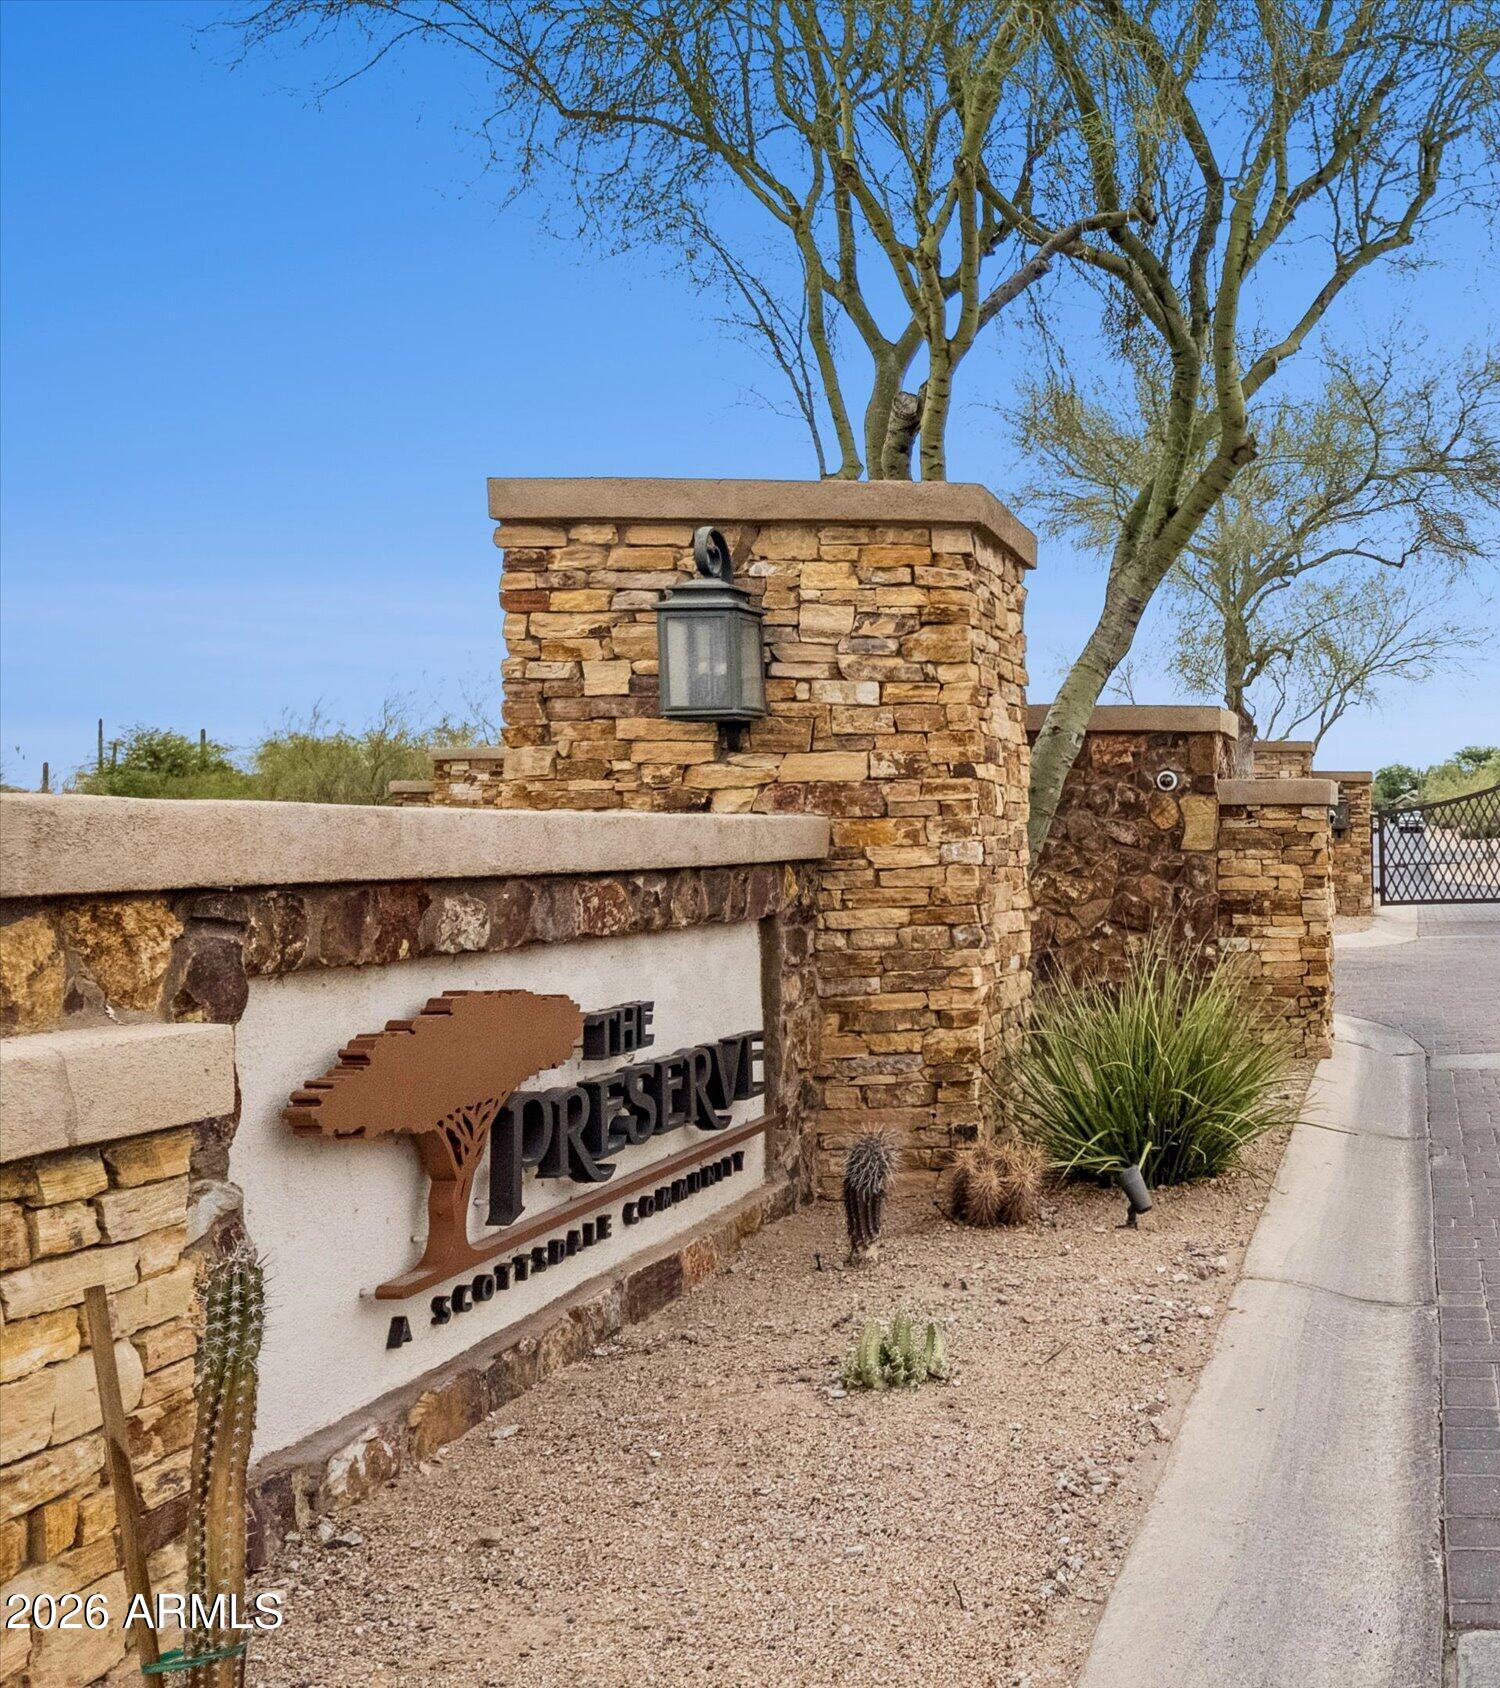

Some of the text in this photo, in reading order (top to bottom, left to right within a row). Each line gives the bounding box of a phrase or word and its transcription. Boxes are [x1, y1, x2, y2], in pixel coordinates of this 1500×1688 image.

[485, 1030, 765, 1226] PRESERVE
[582, 1000, 655, 1061] THE
[386, 1150, 745, 1349] A SCOTTSDALE COMMUNITY
